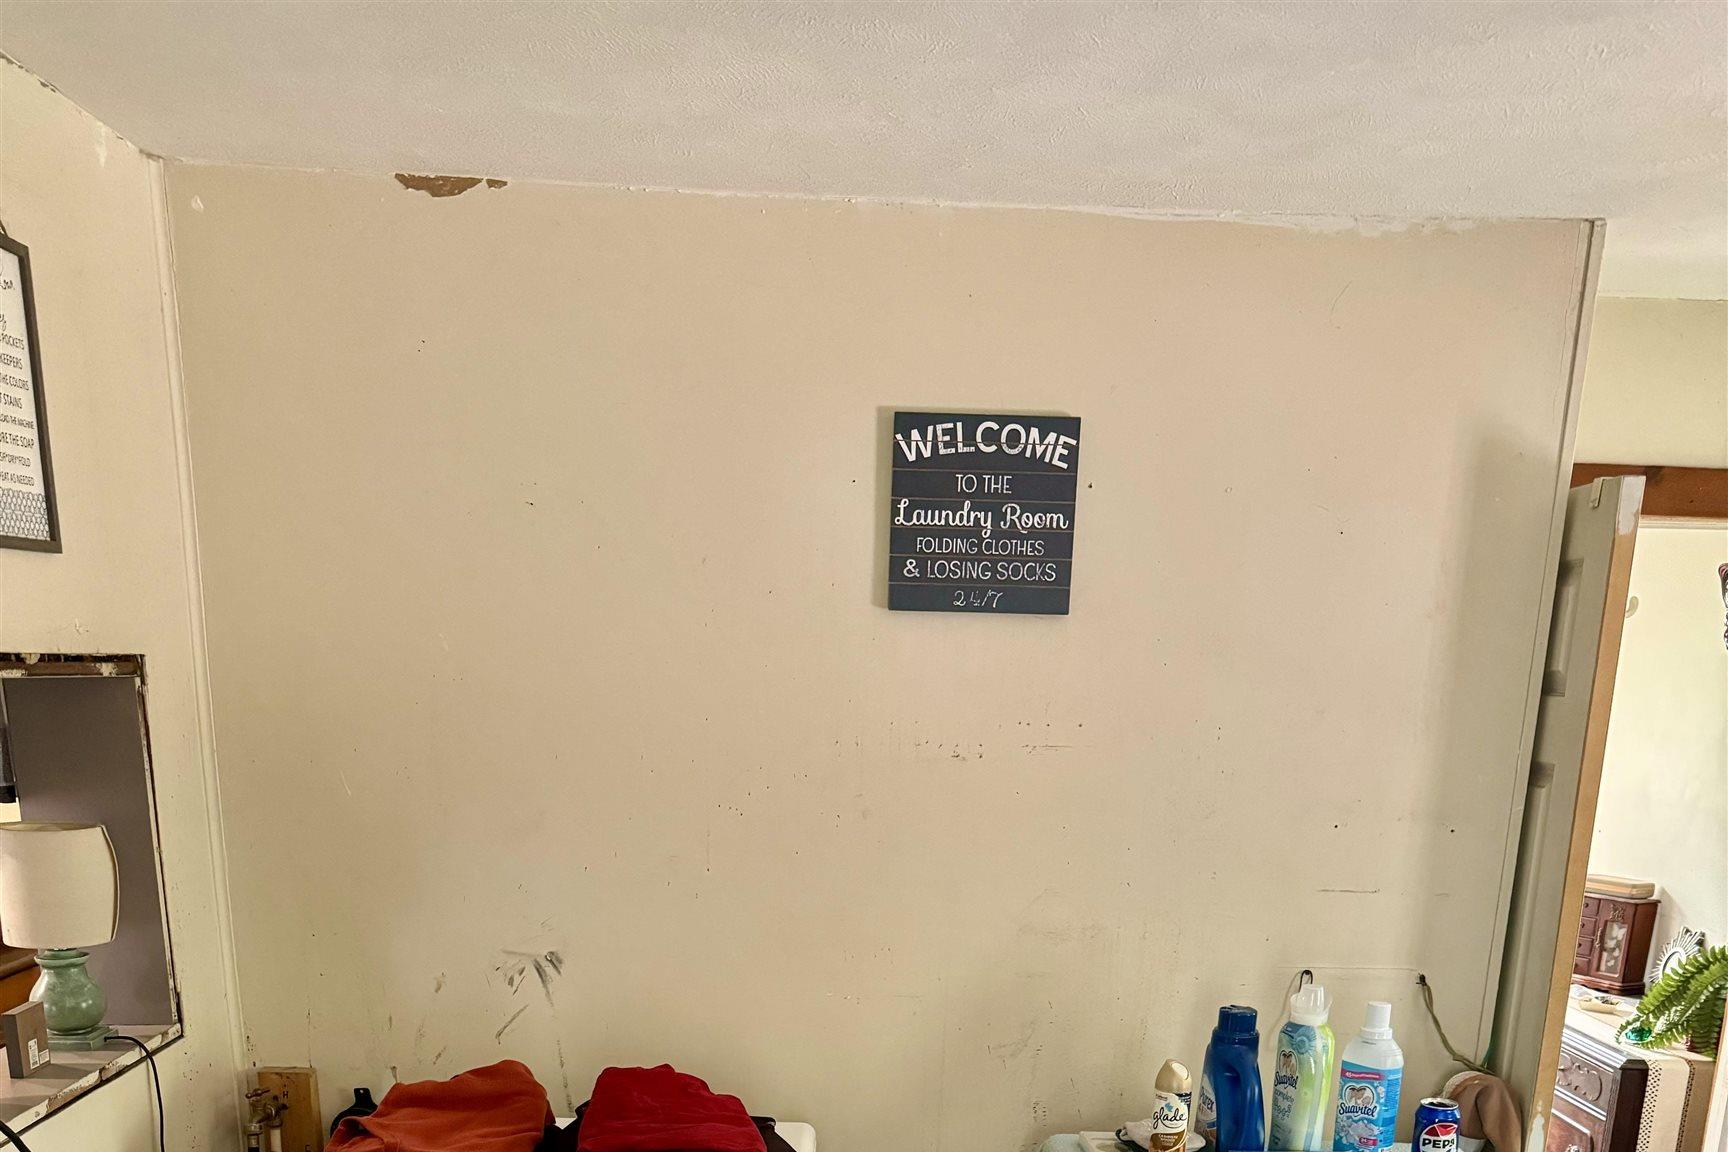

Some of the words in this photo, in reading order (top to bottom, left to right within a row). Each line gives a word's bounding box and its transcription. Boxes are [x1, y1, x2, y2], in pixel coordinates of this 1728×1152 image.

[895, 421, 1077, 469] WELCOME
[955, 474, 977, 493] TO
[982, 475, 1012, 494] THE
[895, 499, 993, 538] Laundry
[1000, 503, 1069, 533] Room
[916, 537, 978, 553] FOLDING
[982, 539, 1045, 556] CLOTHES
[903, 559, 920, 577] &
[927, 561, 991, 579] LOSING
[996, 562, 1057, 582] SOCKS
[953, 589, 1003, 608] 24/7
[1152, 1107, 1187, 1130] glade
[1338, 1102, 1377, 1118] Suavitel
